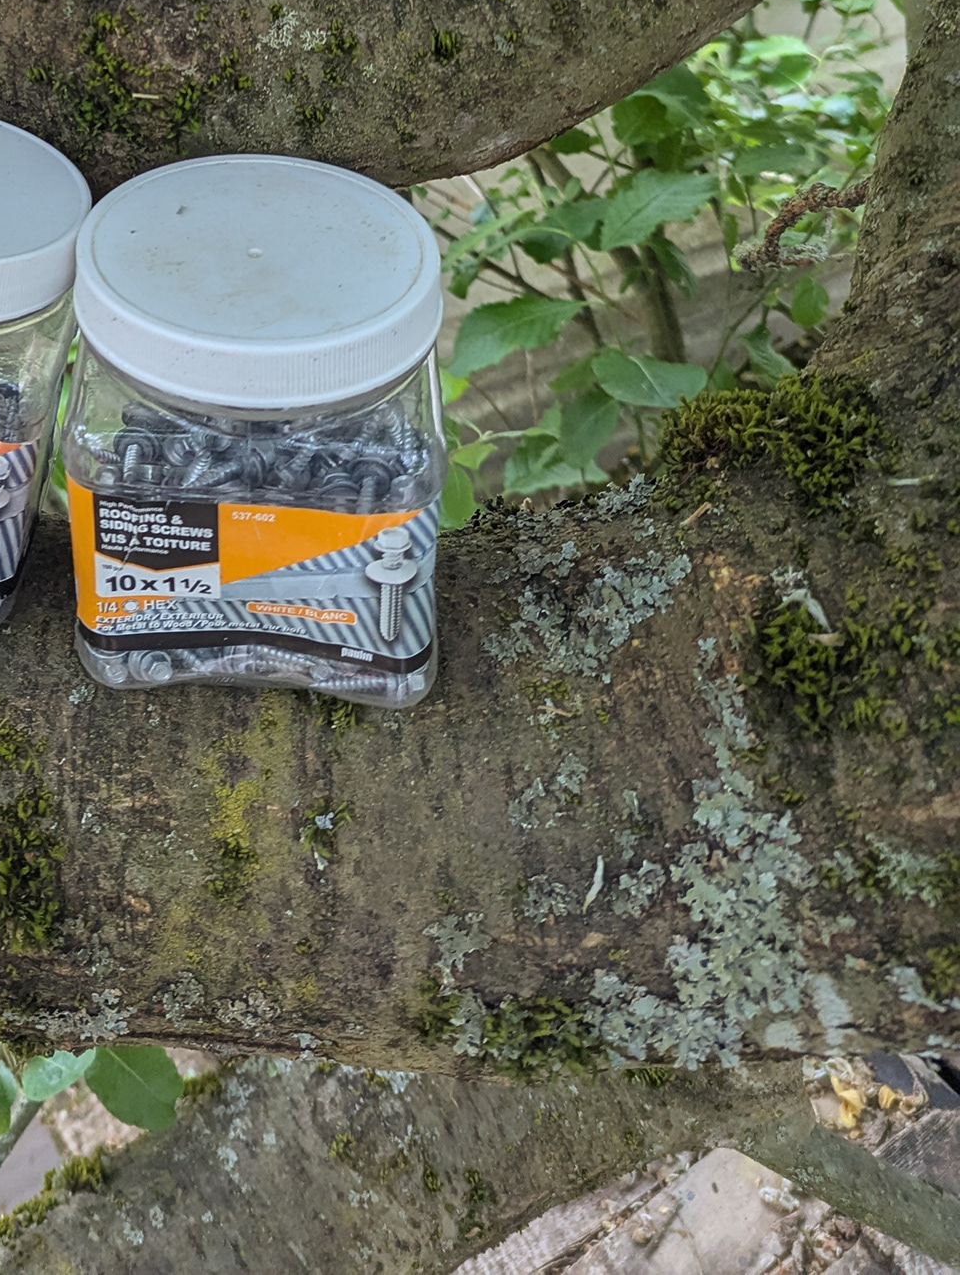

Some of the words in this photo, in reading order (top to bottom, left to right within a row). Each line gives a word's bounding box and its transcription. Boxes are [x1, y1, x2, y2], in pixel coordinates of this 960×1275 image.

[99, 508, 167, 525] ROOFING
[170, 514, 183, 525] &
[99, 519, 149, 533] SIDING
[151, 524, 214, 539] SCREWS
[101, 532, 127, 544] VIS
[143, 536, 212, 551] TOITURE
[97, 601, 118, 613] 1/4
[143, 600, 178, 610] HEX
[255, 604, 297, 615] WHITE
[304, 609, 349, 621] BLANC
[117, 621, 147, 632] Metal
[149, 620, 159, 629] to
